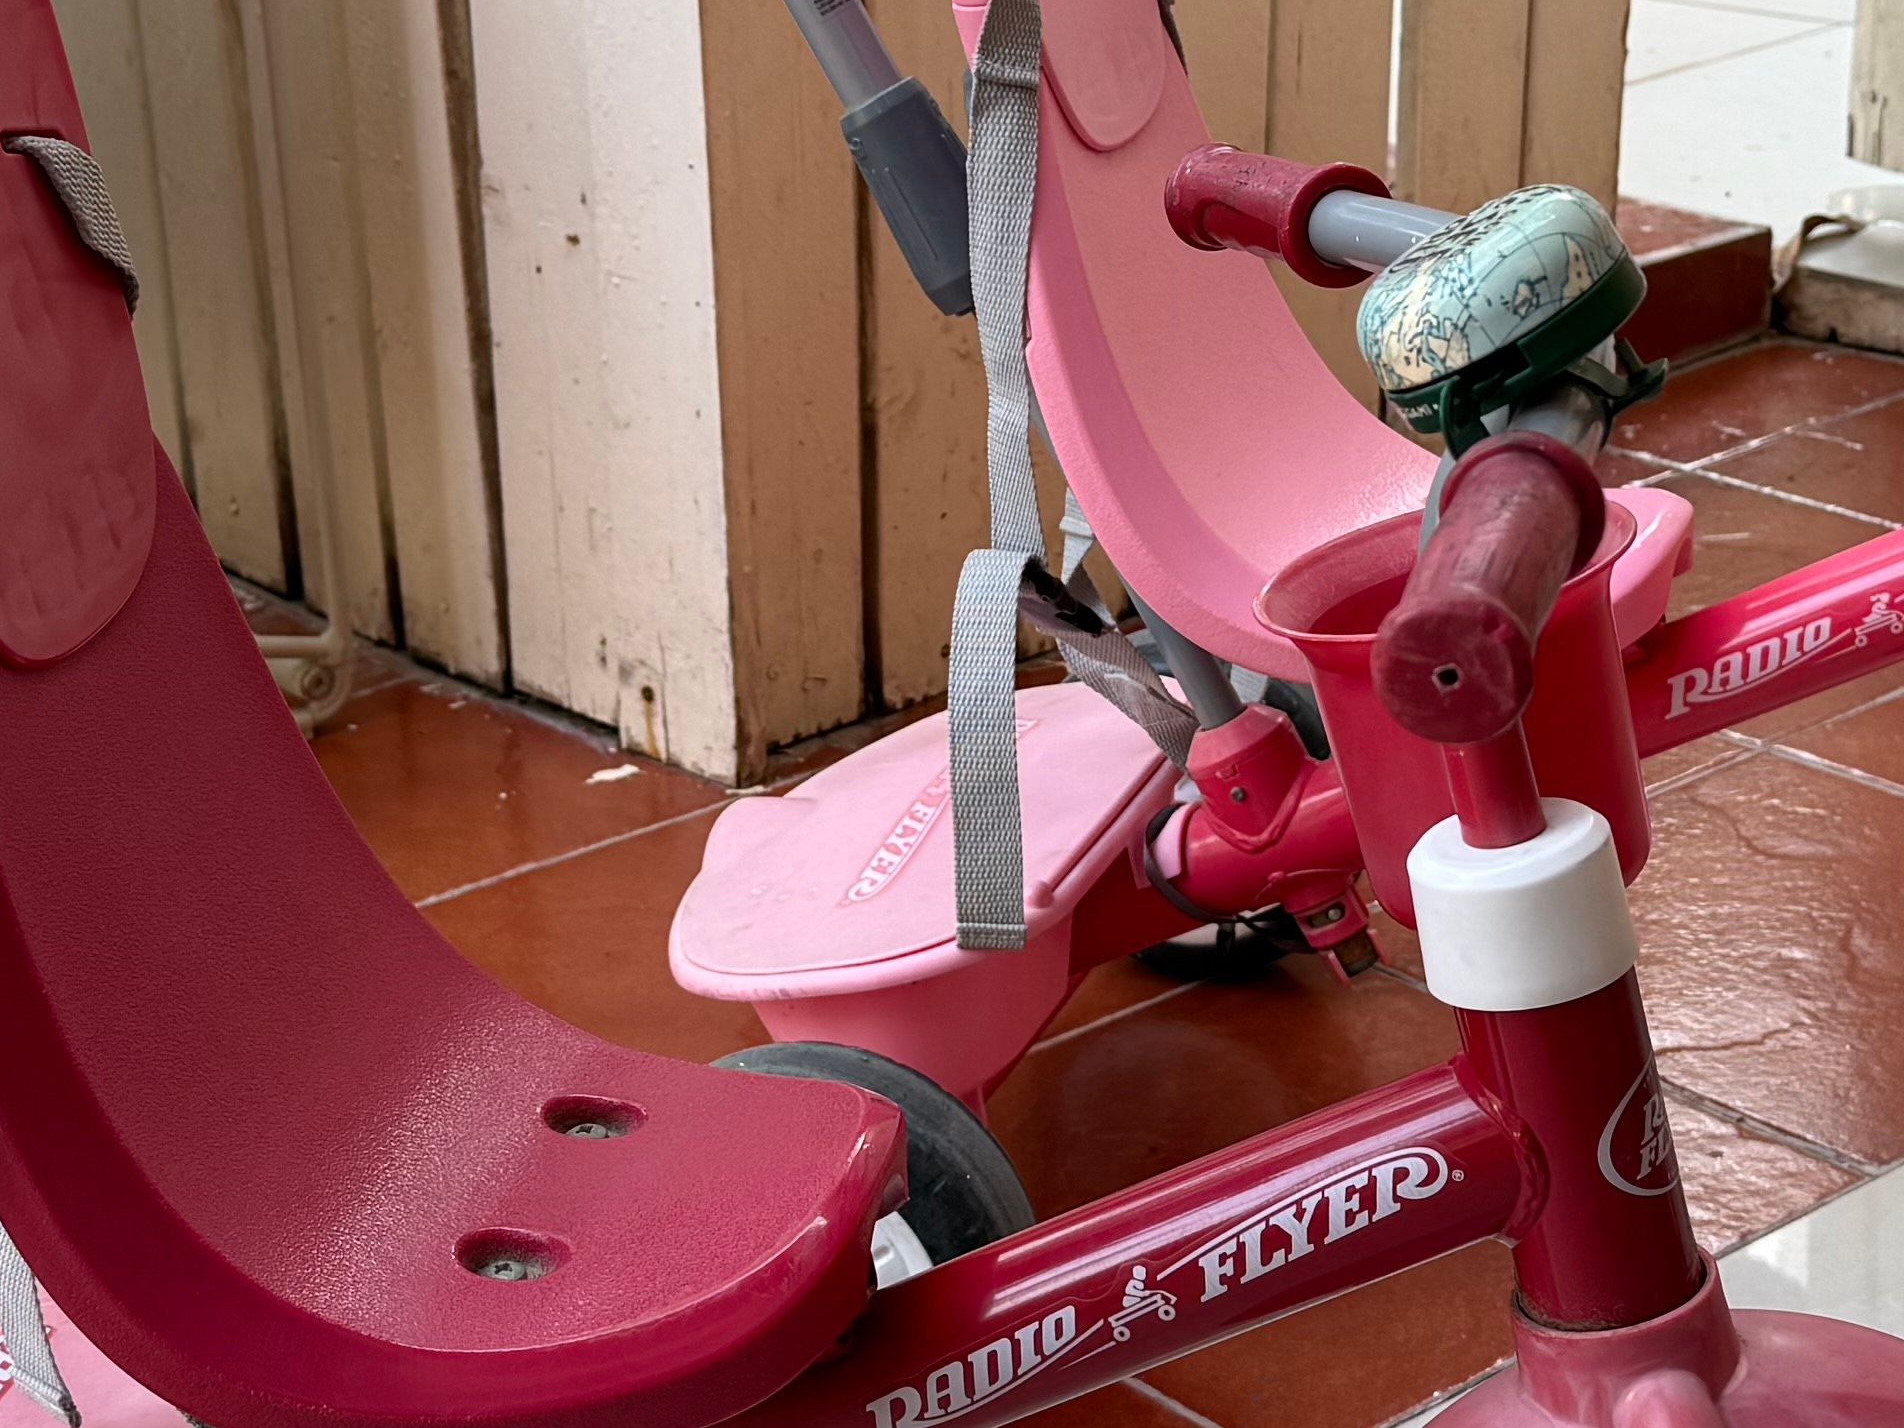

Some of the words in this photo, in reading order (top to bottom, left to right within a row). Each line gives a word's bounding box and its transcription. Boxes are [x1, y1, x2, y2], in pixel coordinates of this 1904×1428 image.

[1665, 617, 1832, 720] RADIO
[848, 800, 935, 903] FLYER
[1199, 1147, 1449, 1304] FLYER
